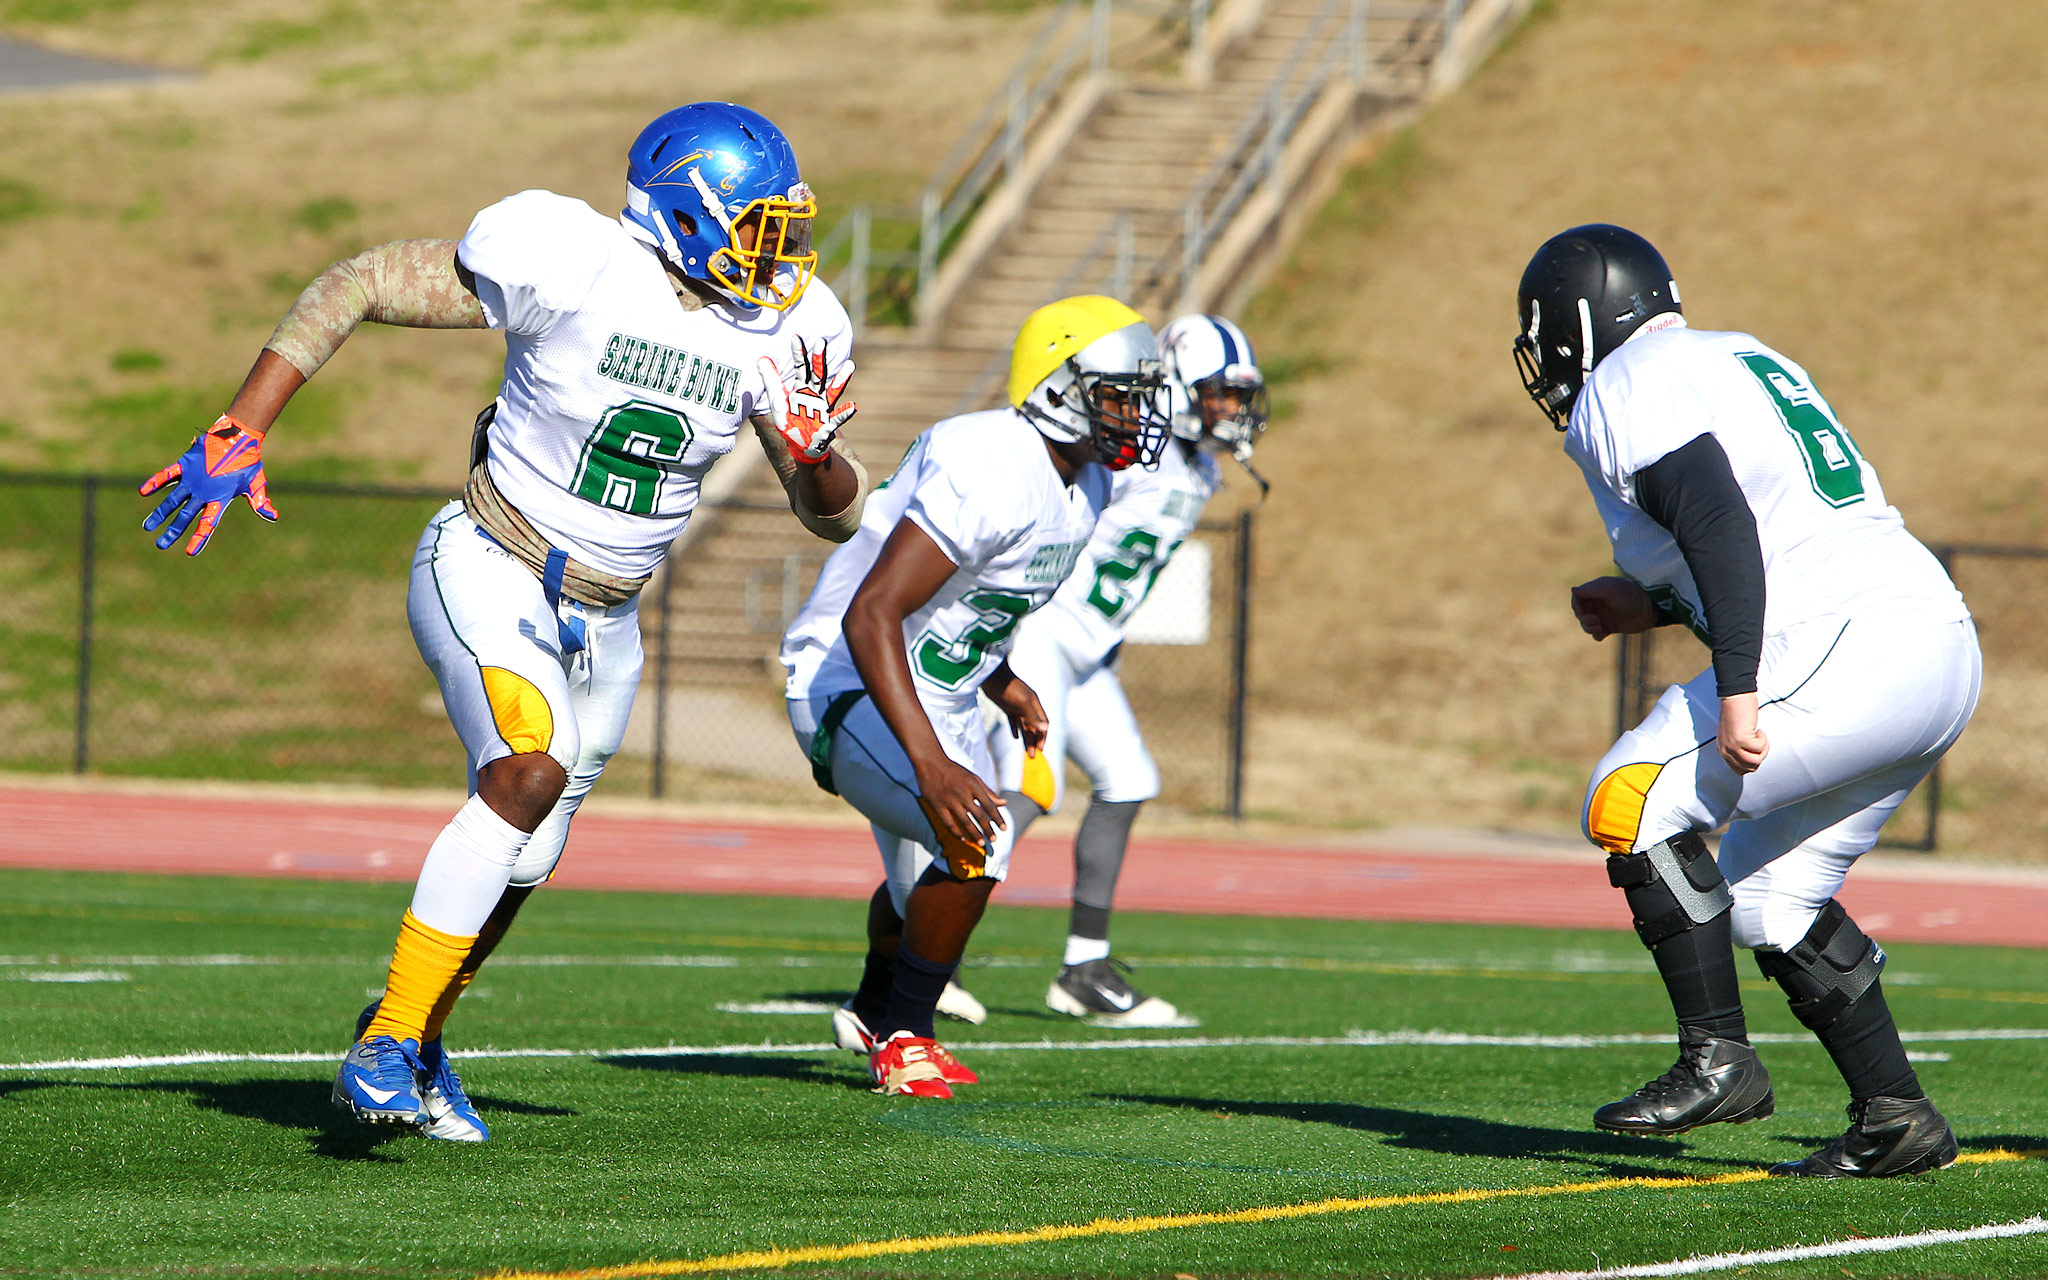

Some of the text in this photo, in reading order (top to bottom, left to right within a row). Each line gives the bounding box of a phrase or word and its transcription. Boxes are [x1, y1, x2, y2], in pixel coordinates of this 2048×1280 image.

[598, 332, 742, 414] SHRINE BOWL
[568, 399, 694, 518] 6
